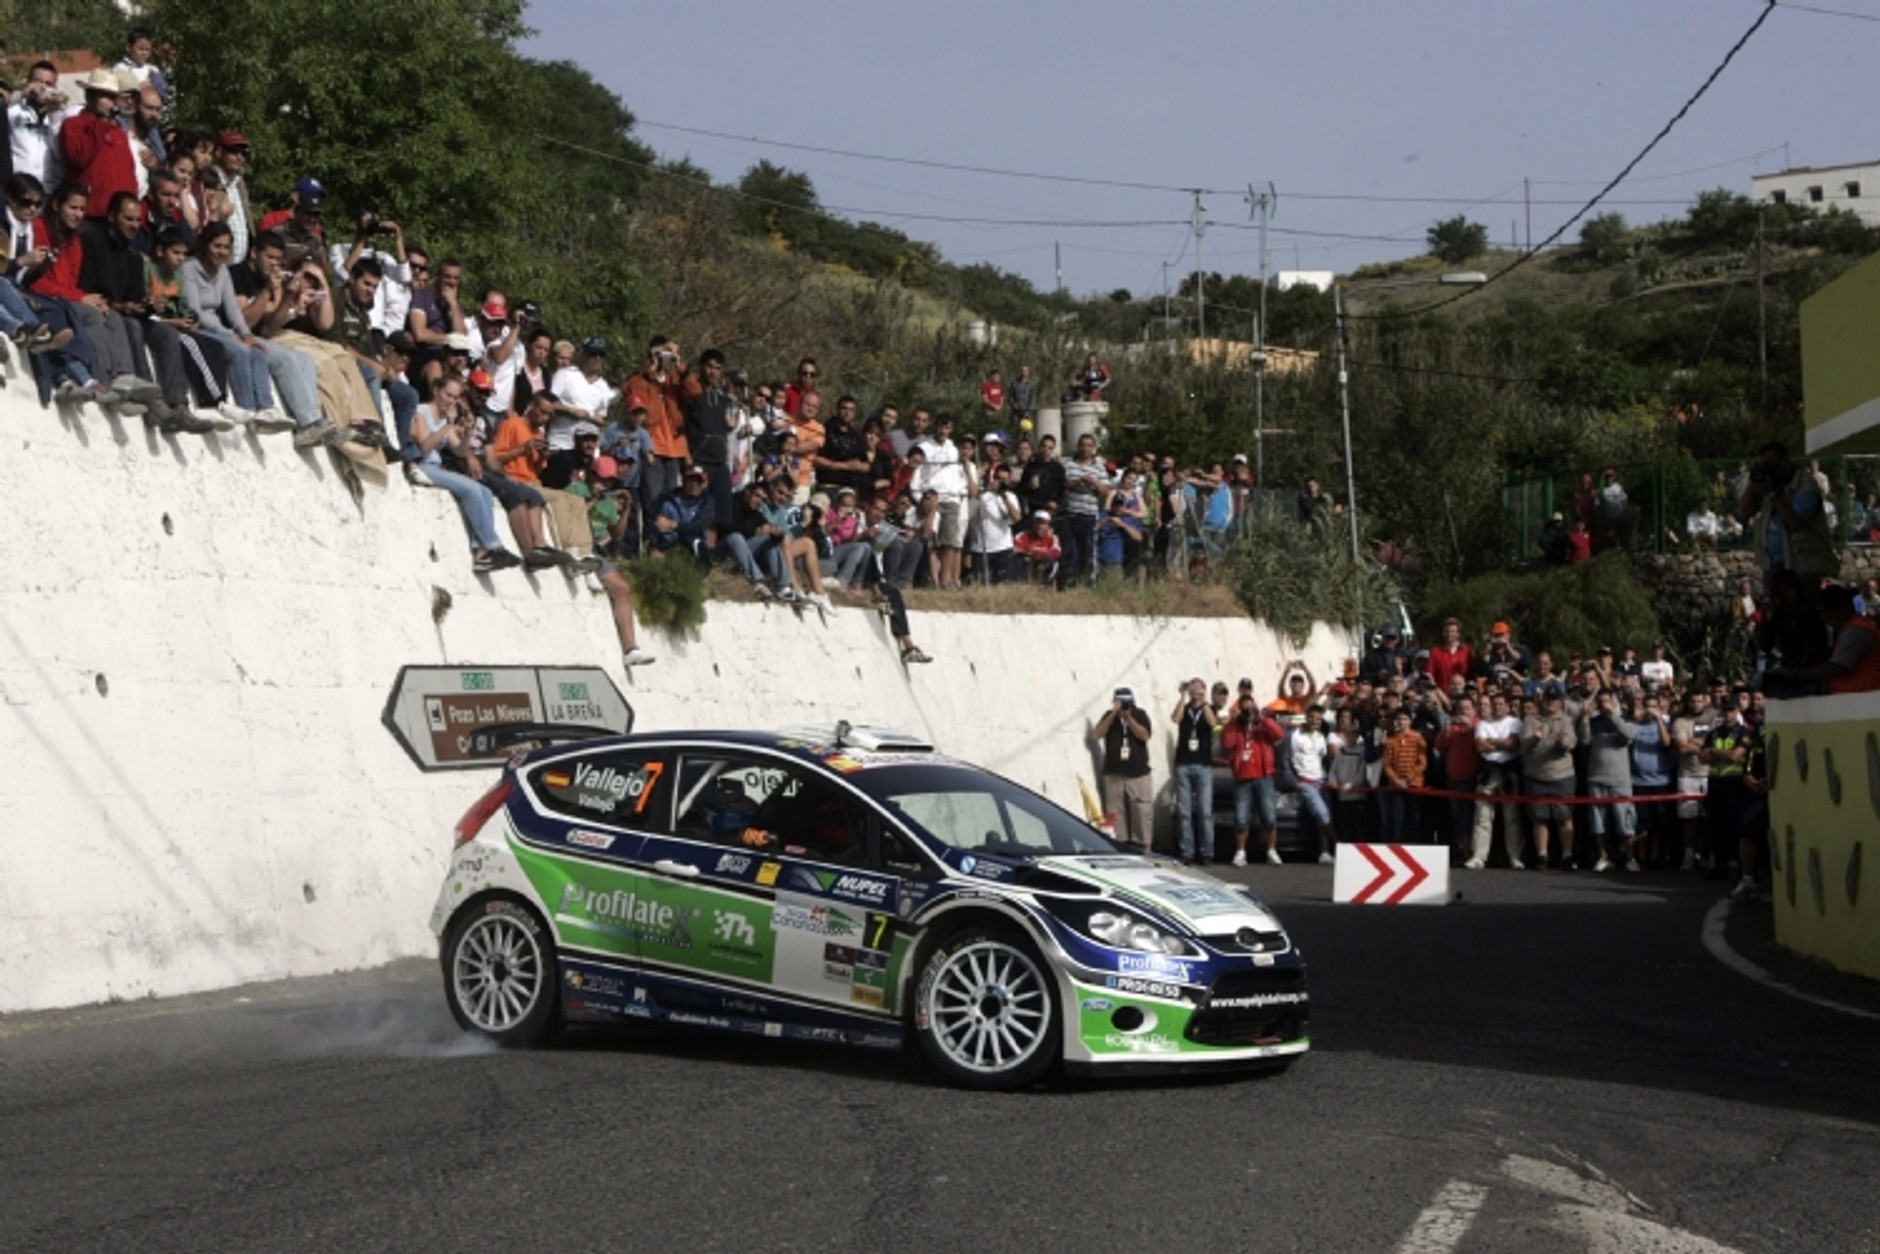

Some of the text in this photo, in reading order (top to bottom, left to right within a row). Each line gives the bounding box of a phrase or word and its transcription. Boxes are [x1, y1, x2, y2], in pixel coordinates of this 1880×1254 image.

[574, 762, 645, 801] Vallejo
[634, 761, 664, 813] 7
[837, 875, 887, 897] NUPEL
[873, 914, 888, 950] 7
